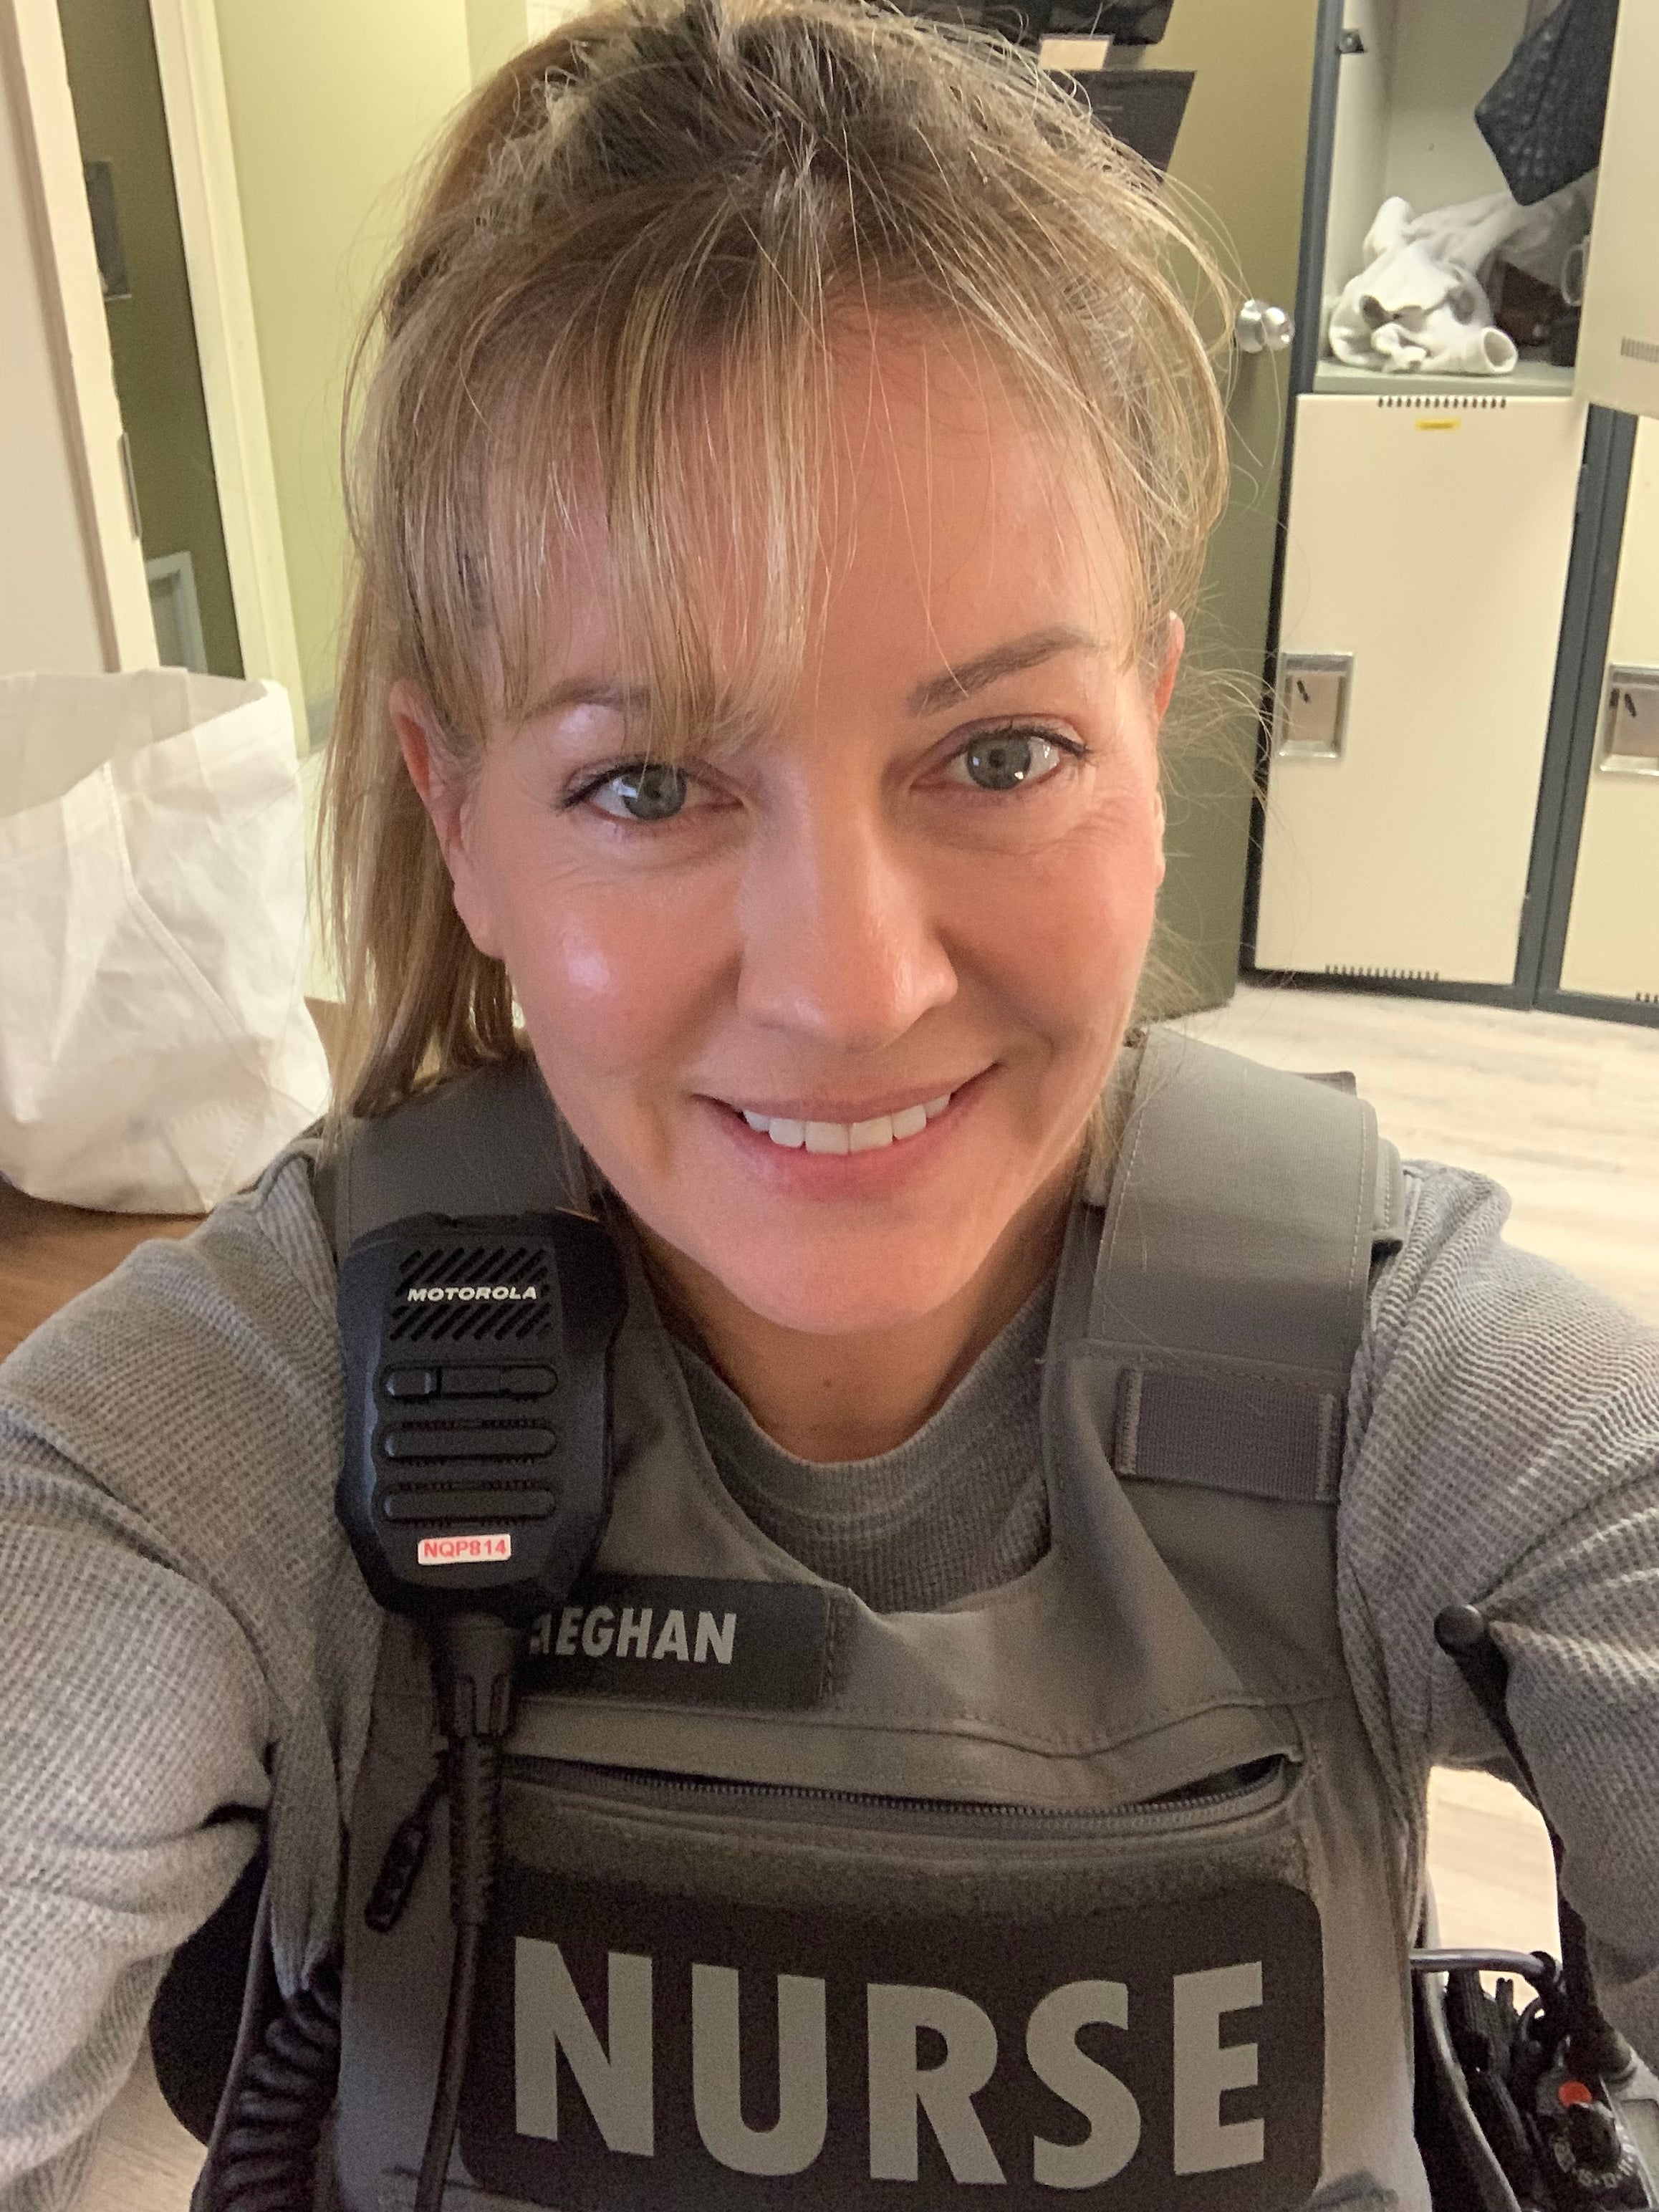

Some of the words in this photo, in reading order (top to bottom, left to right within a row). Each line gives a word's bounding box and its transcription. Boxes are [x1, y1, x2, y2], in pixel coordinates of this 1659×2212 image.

[407, 1287, 537, 1302] MOTOROLA
[424, 1539, 506, 1558] NQP814
[514, 1936, 1264, 2190] NURSE
